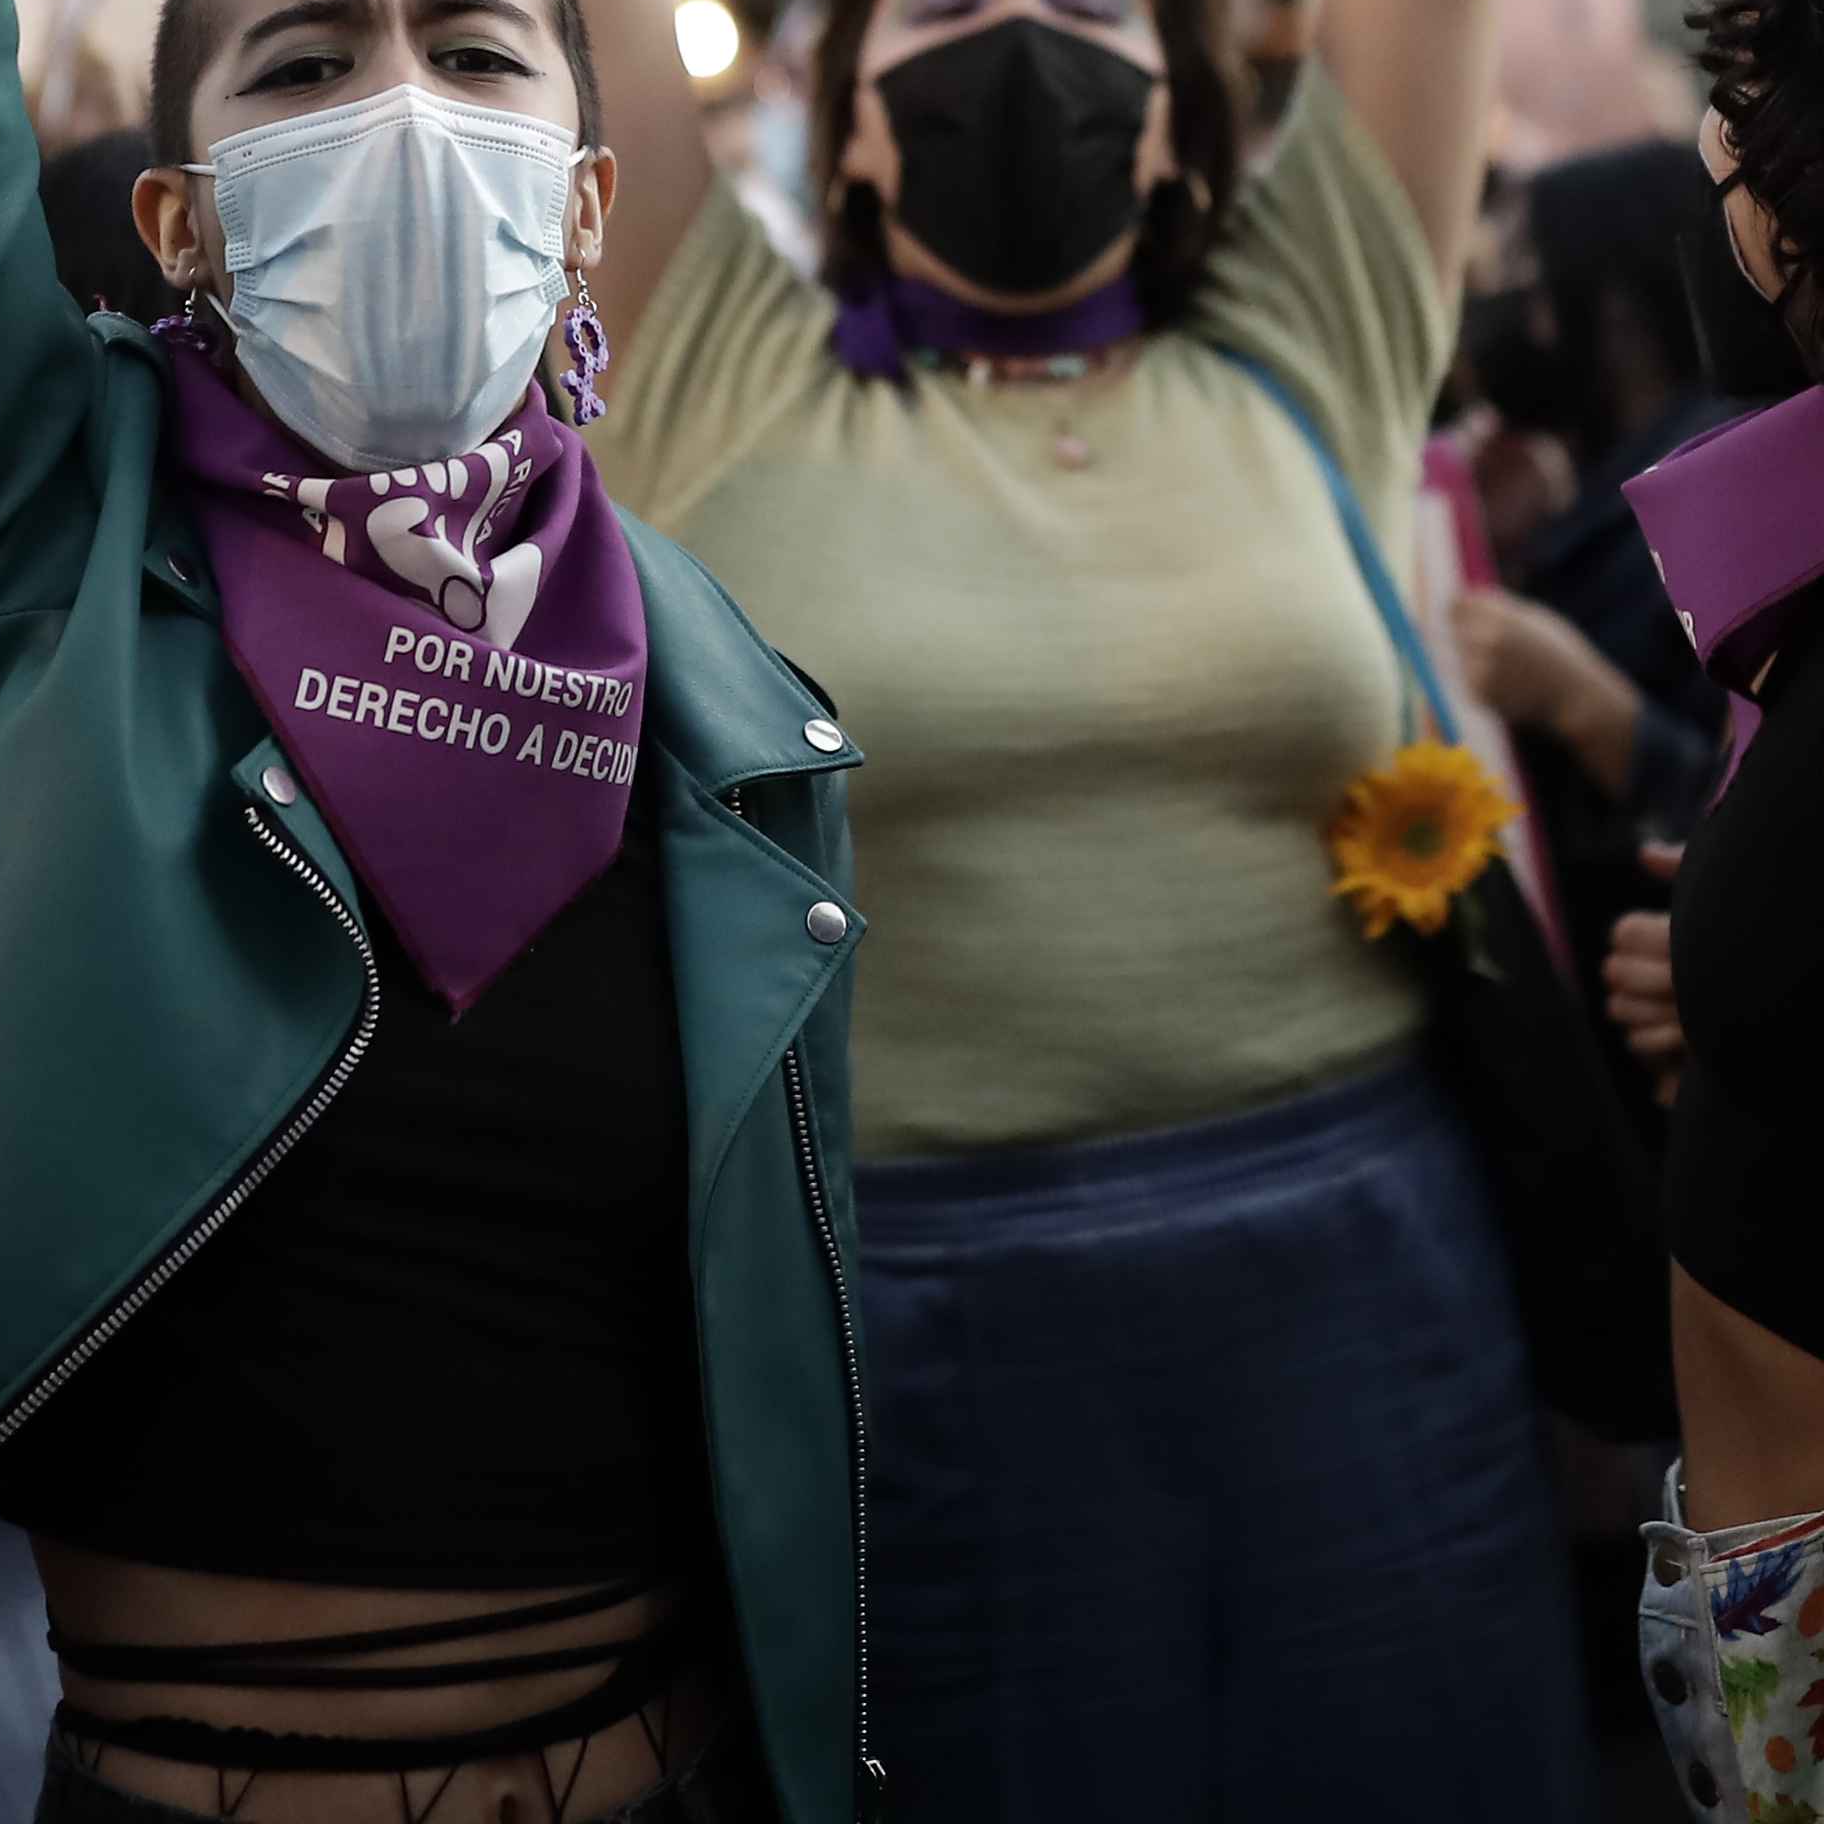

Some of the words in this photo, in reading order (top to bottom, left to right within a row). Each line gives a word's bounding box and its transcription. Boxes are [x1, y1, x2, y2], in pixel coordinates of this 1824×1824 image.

[294, 668, 511, 755] DERECHO
[516, 724, 544, 766] A
[384, 626, 474, 681] POR
[484, 650, 633, 718] NUESTRO
